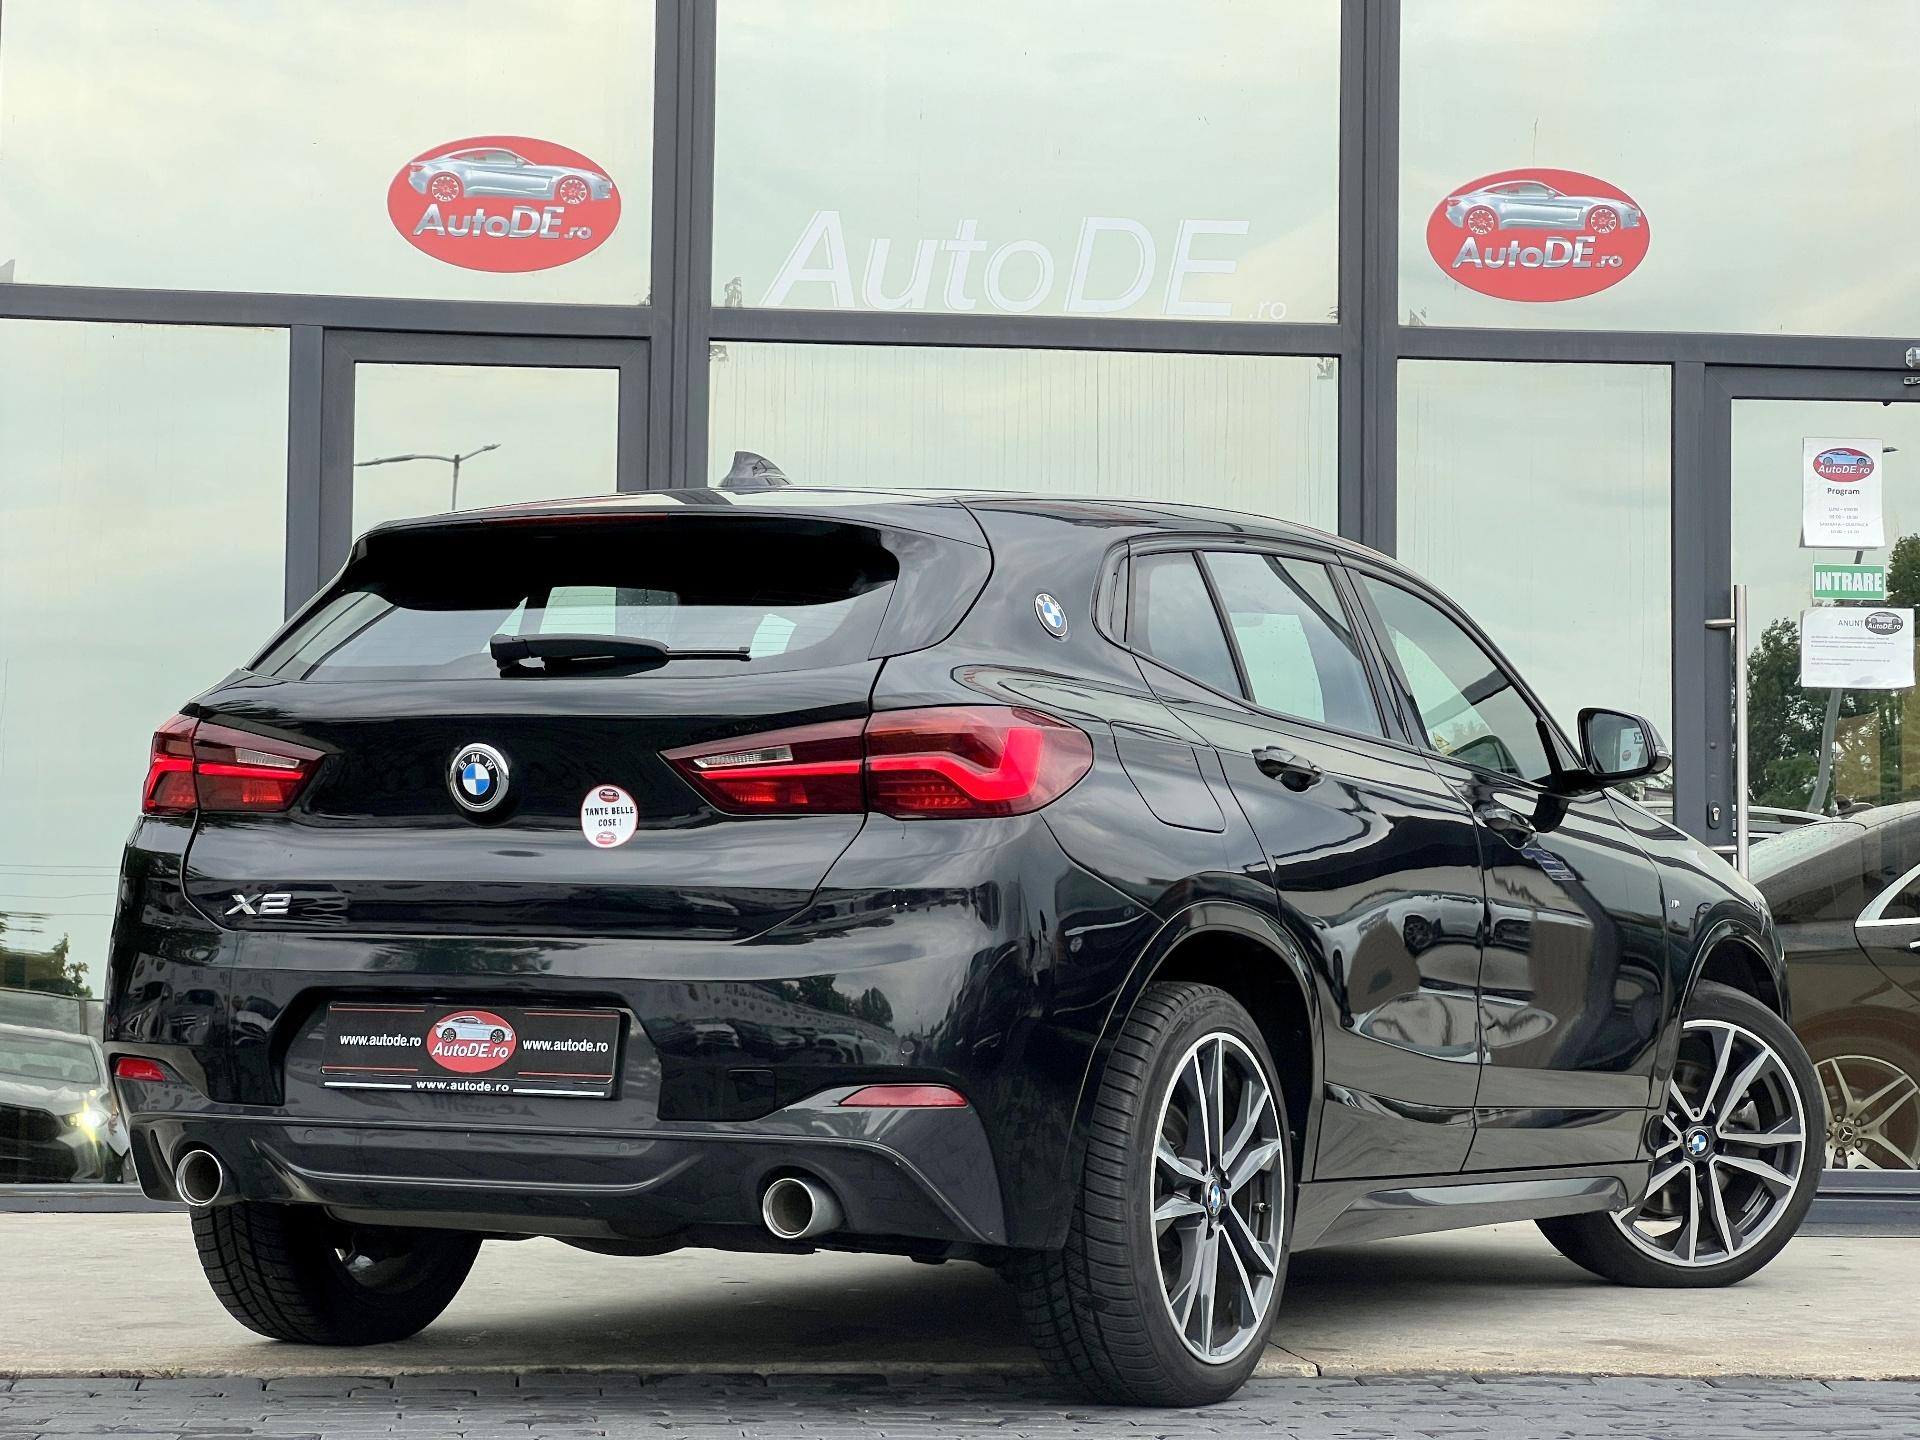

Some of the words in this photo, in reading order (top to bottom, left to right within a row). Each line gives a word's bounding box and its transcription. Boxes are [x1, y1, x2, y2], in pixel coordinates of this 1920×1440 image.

[1827, 487, 1860, 497] Program
[1815, 571, 1883, 592] INTRARE
[584, 807, 609, 816] TANTE
[611, 806, 635, 815] BELLE
[598, 818, 617, 827] COSE
[224, 893, 292, 915] X2
[339, 1033, 422, 1047] www.autode.ro
[522, 1038, 609, 1053] www.autode.ro
[431, 1042, 509, 1059] AutoDE.ro
[416, 1079, 509, 1092] www.autode.ro
